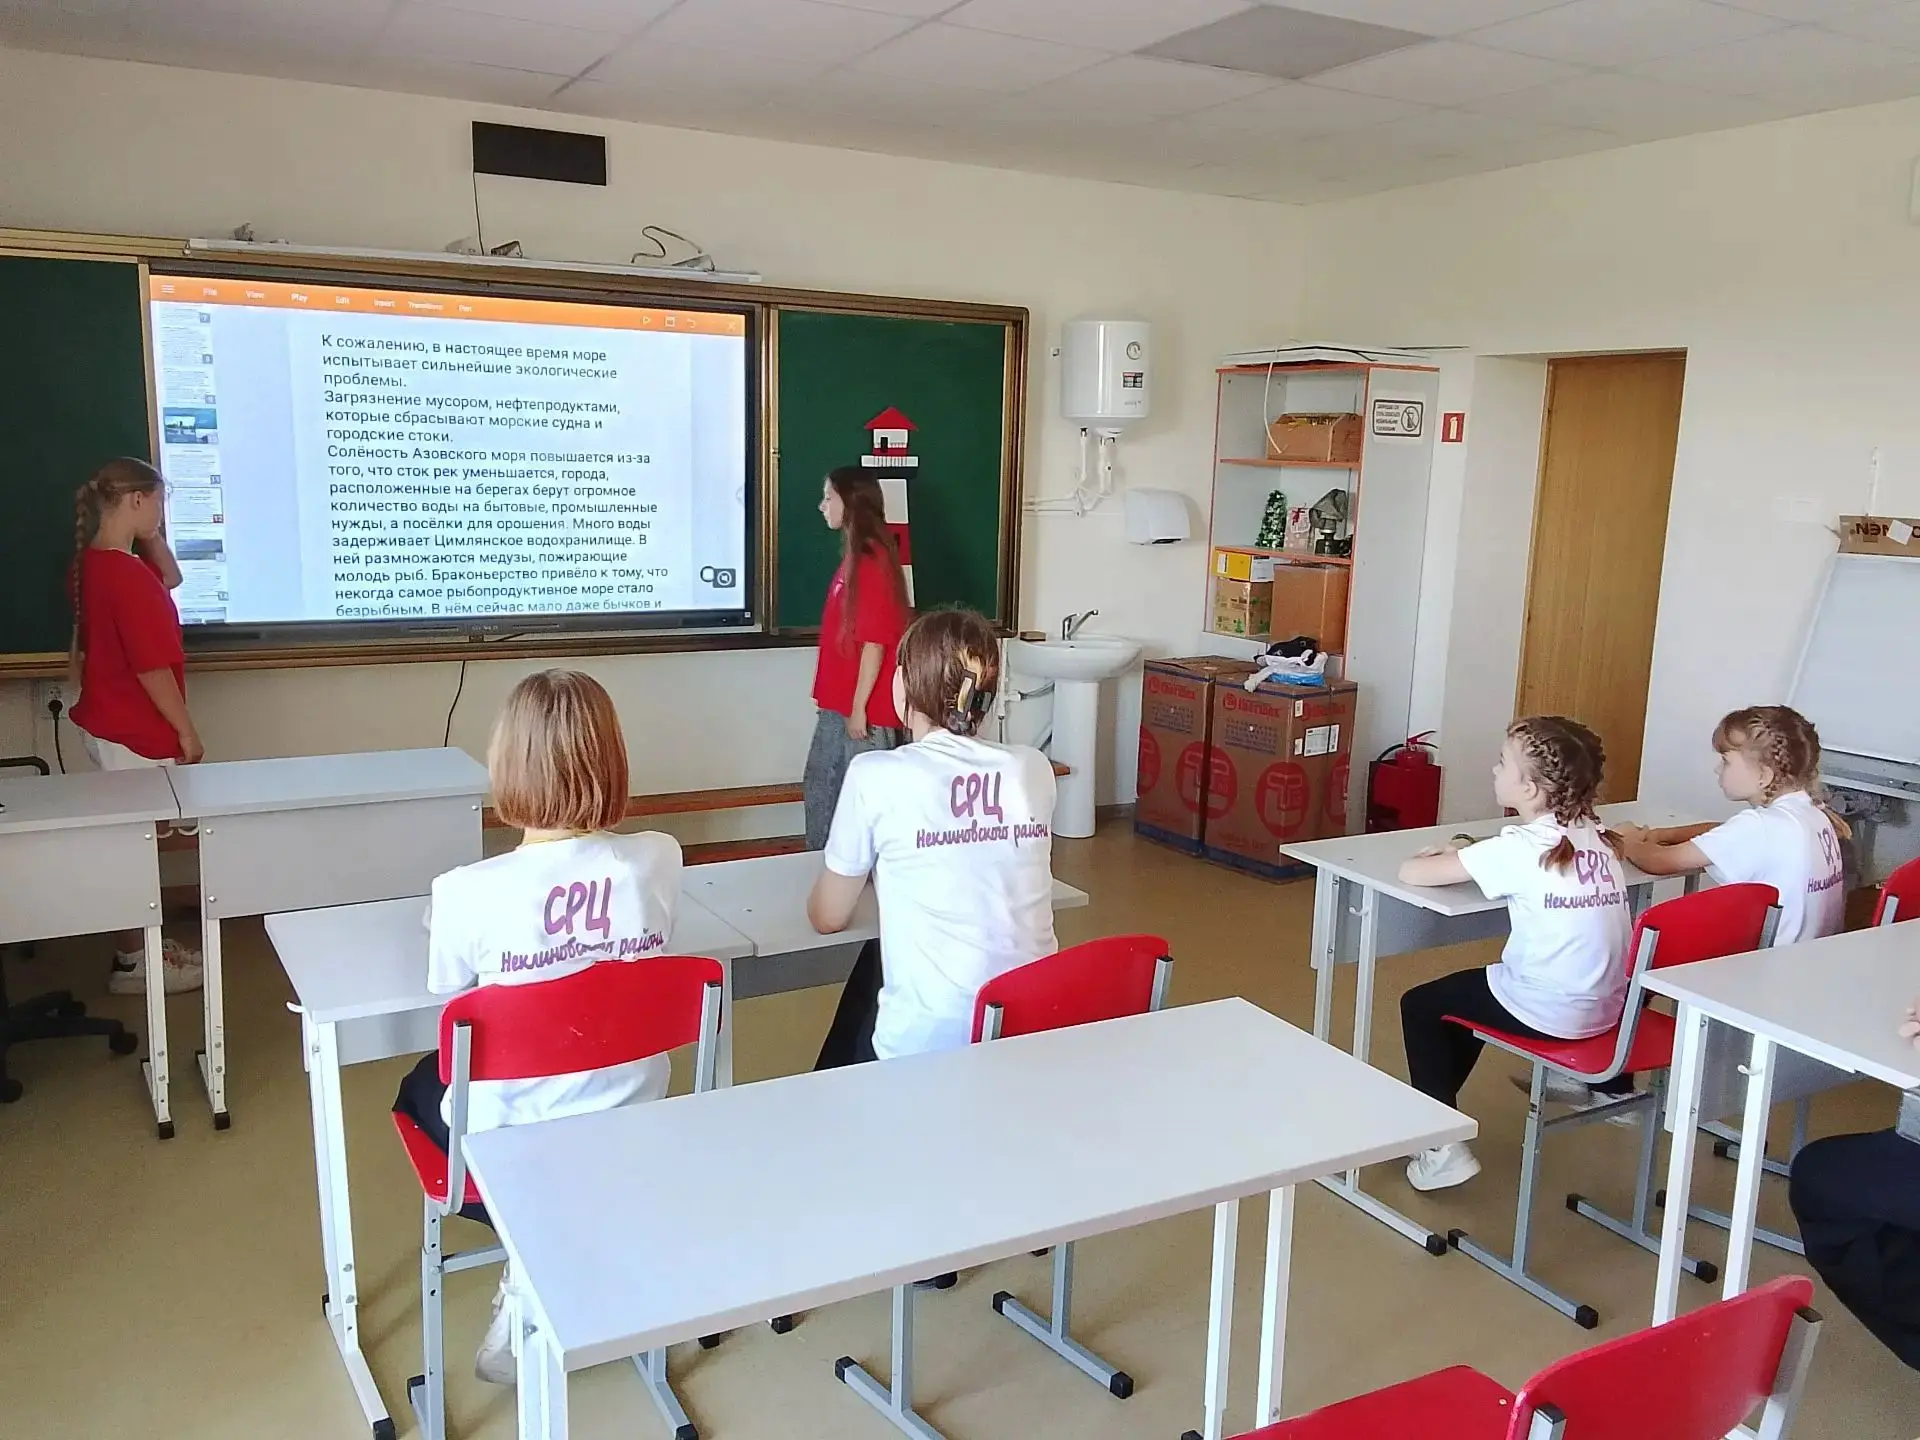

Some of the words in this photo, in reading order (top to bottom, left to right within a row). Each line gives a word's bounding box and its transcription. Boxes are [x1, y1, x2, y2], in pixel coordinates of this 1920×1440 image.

[321, 333, 333, 347] К
[336, 337, 428, 354] сожалению,
[432, 342, 441, 353] в
[445, 343, 522, 359] настоящее
[526, 348, 568, 362] время
[572, 350, 606, 364] море
[322, 355, 418, 370] испытывает
[421, 358, 511, 374] сильнейшие
[515, 364, 617, 379] экологические
[323, 372, 406, 388] проблемы.
[323, 389, 421, 409] Загрязнение
[425, 396, 492, 411] мусором,
[495, 396, 620, 416] нефтепродуктами,
[325, 410, 390, 425] которые
[394, 409, 485, 428] сбрасывают
[488, 416, 548, 430] морские
[551, 418, 590, 431] судна
[594, 420, 602, 429] и
[326, 428, 404, 444] городские
[408, 431, 453, 443] стоки.
[327, 444, 408, 459] Солёность
[411, 447, 487, 460] Азовского
[491, 451, 525, 464] моря
[530, 452, 614, 463] повышается
[617, 453, 650, 464] из-за
[327, 465, 364, 478] того,
[367, 465, 392, 476] что
[396, 466, 430, 477] сток
[433, 467, 458, 480] рек
[461, 467, 558, 481] уменьшается,
[561, 469, 609, 482] города,
[329, 483, 451, 498] расположенные
[454, 485, 472, 495] на
[475, 482, 529, 498] берегах
[532, 483, 570, 499] берут
[573, 486, 636, 499] огромное
[330, 500, 417, 512] количество
[421, 502, 458, 514] воды
[462, 502, 479, 512] на
[483, 499, 548, 514] бытовые,
[551, 503, 657, 516] промышленные
[331, 519, 387, 532] нужды,
[390, 519, 398, 529] а
[402, 516, 462, 530] посёлки
[466, 519, 492, 531] для
[496, 519, 568, 532] орошения.
[572, 517, 614, 530] Много
[617, 519, 650, 531] воды
[332, 536, 431, 550] задерживает
[434, 534, 523, 548] Цимлянское
[526, 536, 635, 549] водохранилище.
[638, 533, 647, 545] В
[333, 551, 360, 565] ней
[364, 553, 474, 567] размножаются
[479, 553, 535, 566] медузы,
[538, 552, 627, 565] пожирающие
[334, 571, 390, 584] молодь
[394, 568, 427, 584] рыб.
[431, 567, 538, 584] Браконьерство
[600, 568, 608, 578] к
[611, 568, 644, 580] тому,
[646, 568, 668, 577] что
[335, 588, 394, 601] некогда
[398, 587, 443, 598] самое
[446, 583, 578, 600] рыбопродуктивное
[581, 584, 614, 597] море
[617, 583, 653, 594] стало
[335, 602, 427, 616] безрыбным.
[431, 602, 440, 614] В
[444, 602, 472, 614] нём
[475, 601, 524, 613] сейчас
[527, 602, 562, 612] мало
[565, 601, 599, 611] даже
[603, 597, 650, 610] бычков
[654, 600, 661, 608] и
[950, 771, 1003, 824] СРЦ
[916, 819, 1009, 849] Неклиновского
[1574, 849, 1616, 890] СРЦ
[543, 877, 612, 939] СРЦ
